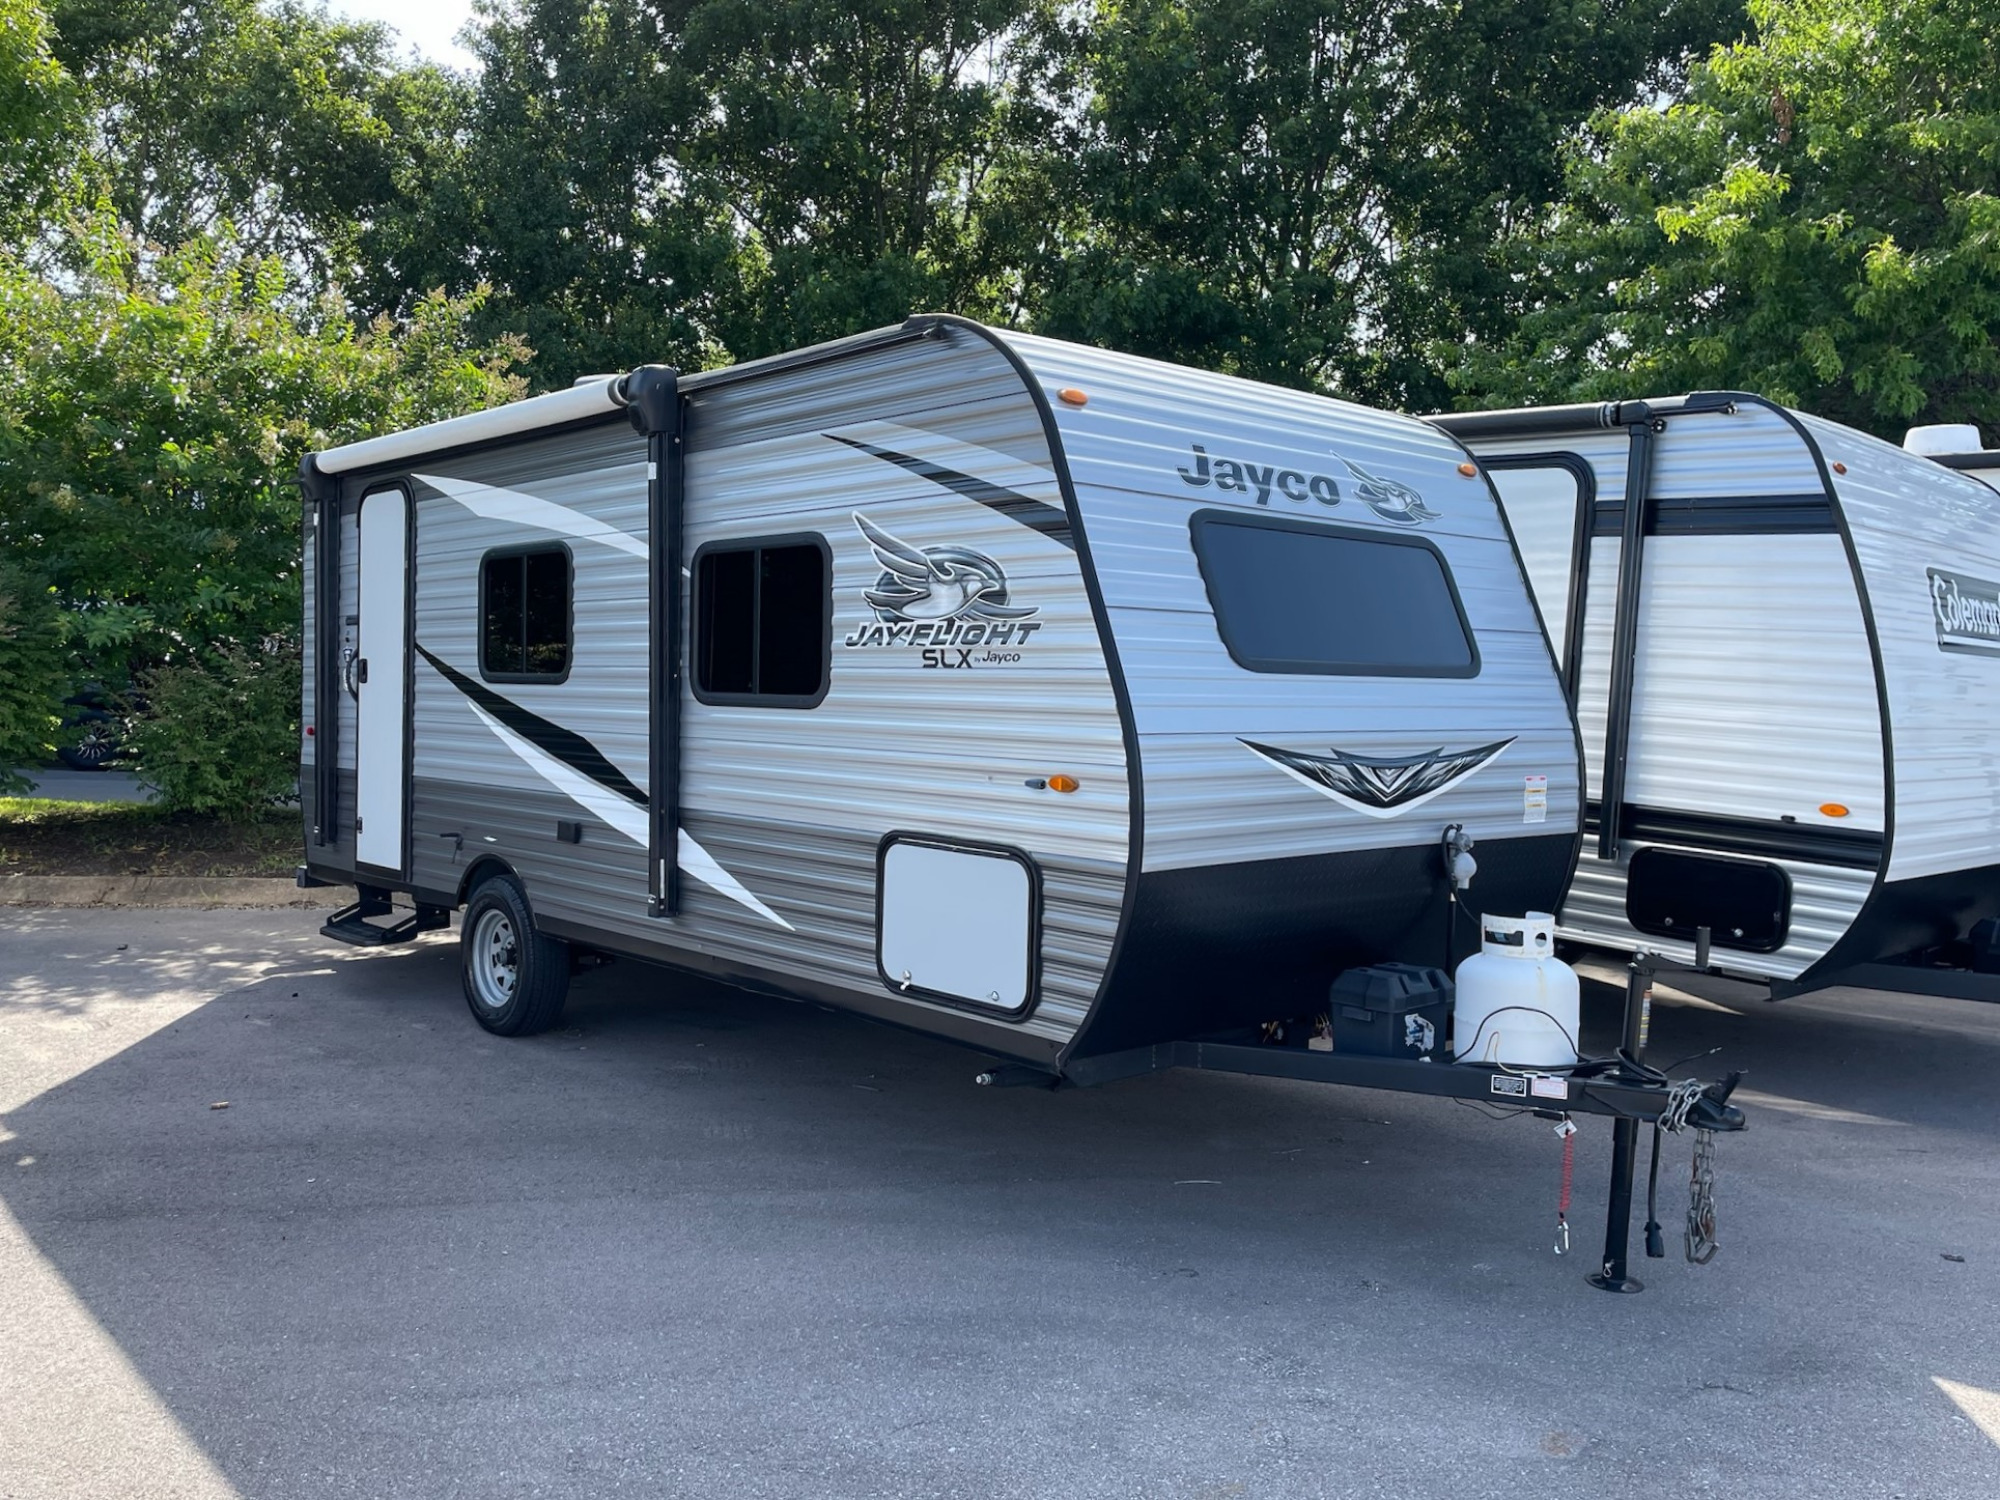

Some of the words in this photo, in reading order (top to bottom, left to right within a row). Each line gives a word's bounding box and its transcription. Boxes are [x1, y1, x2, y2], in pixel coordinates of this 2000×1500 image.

[1177, 444, 1342, 507] Jayco
[922, 649, 973, 669] SLX
[982, 651, 1021, 664] Jayco
